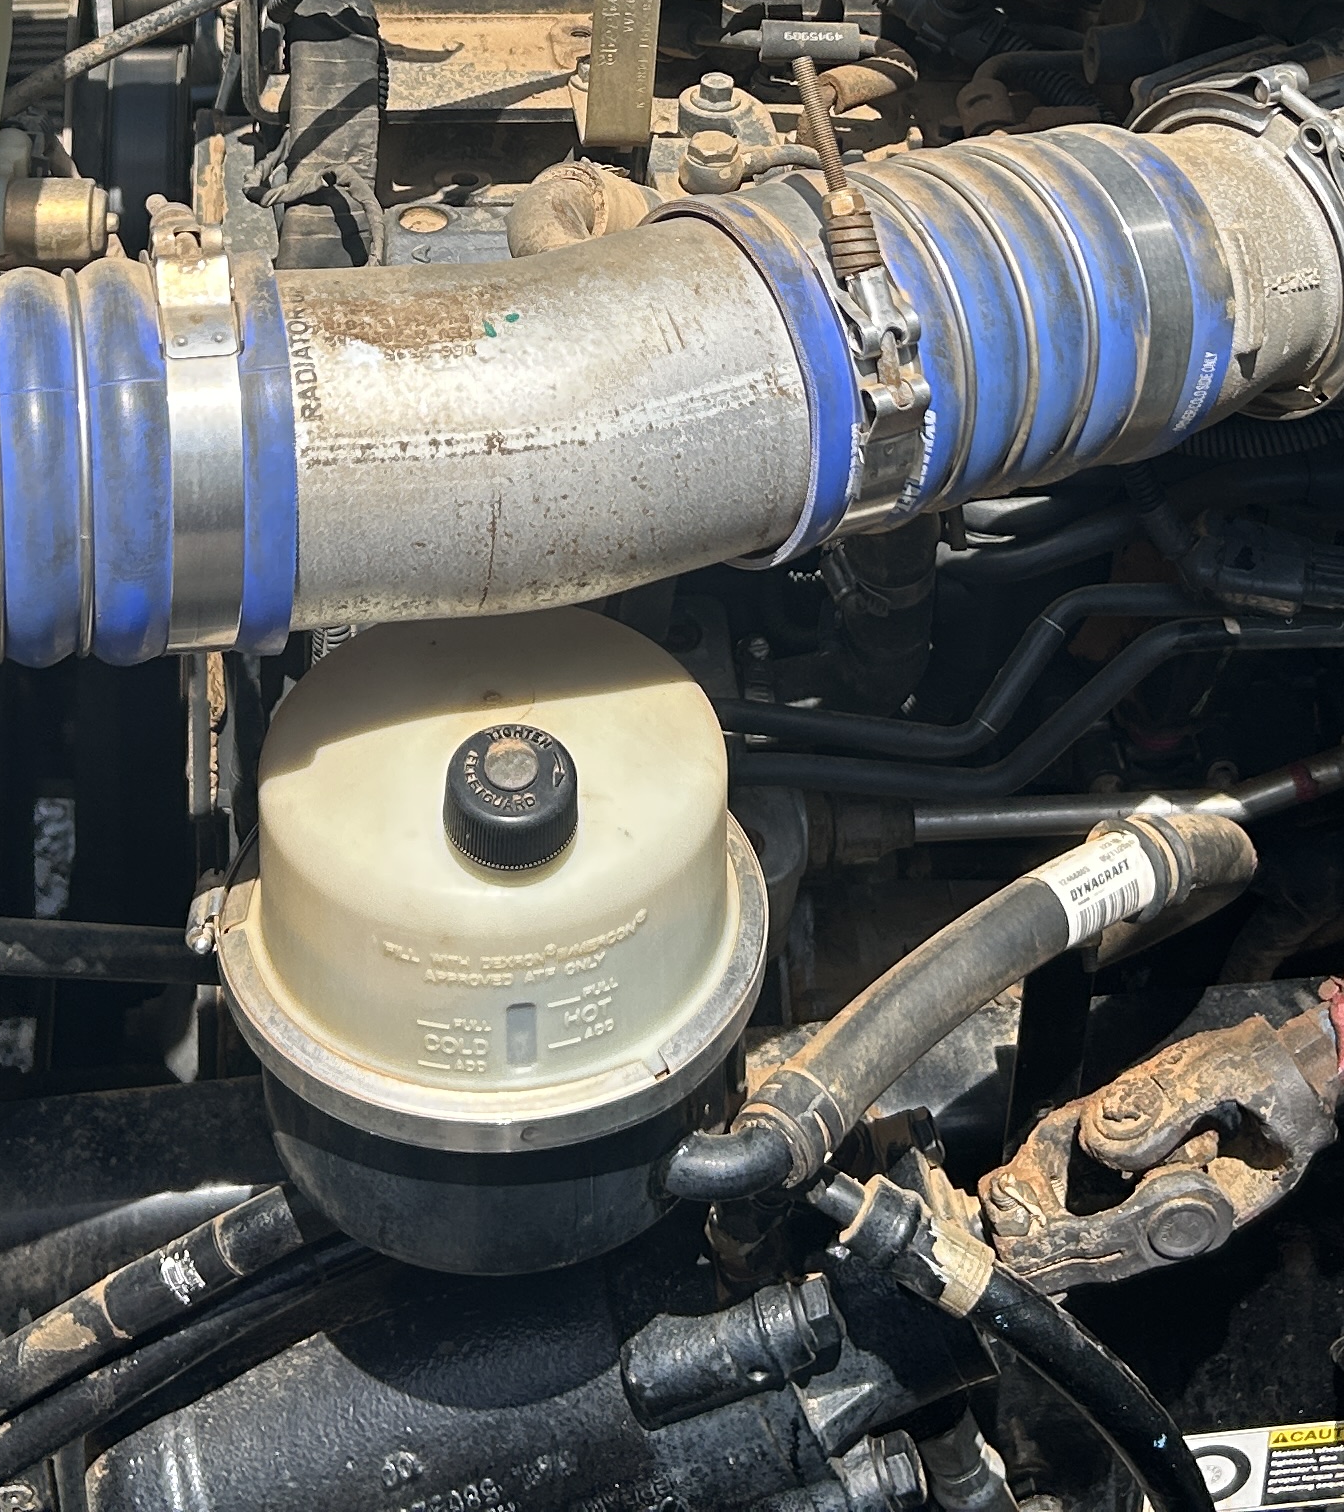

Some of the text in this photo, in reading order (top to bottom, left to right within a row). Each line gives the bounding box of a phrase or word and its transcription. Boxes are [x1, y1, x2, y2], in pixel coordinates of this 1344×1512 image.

[286, 306, 324, 423] RADIATOR
[486, 725, 553, 750] TIGHTEN
[1069, 857, 1130, 903] DYNACRAFT
[423, 951, 606, 987] APPROVED ATF ONLY
[581, 977, 619, 999] FULL
[563, 996, 613, 1028] HOT
[453, 1017, 493, 1033] FULL
[583, 1018, 615, 1039] ADD
[422, 1033, 490, 1056] COLD
[455, 1058, 488, 1073] ADD
